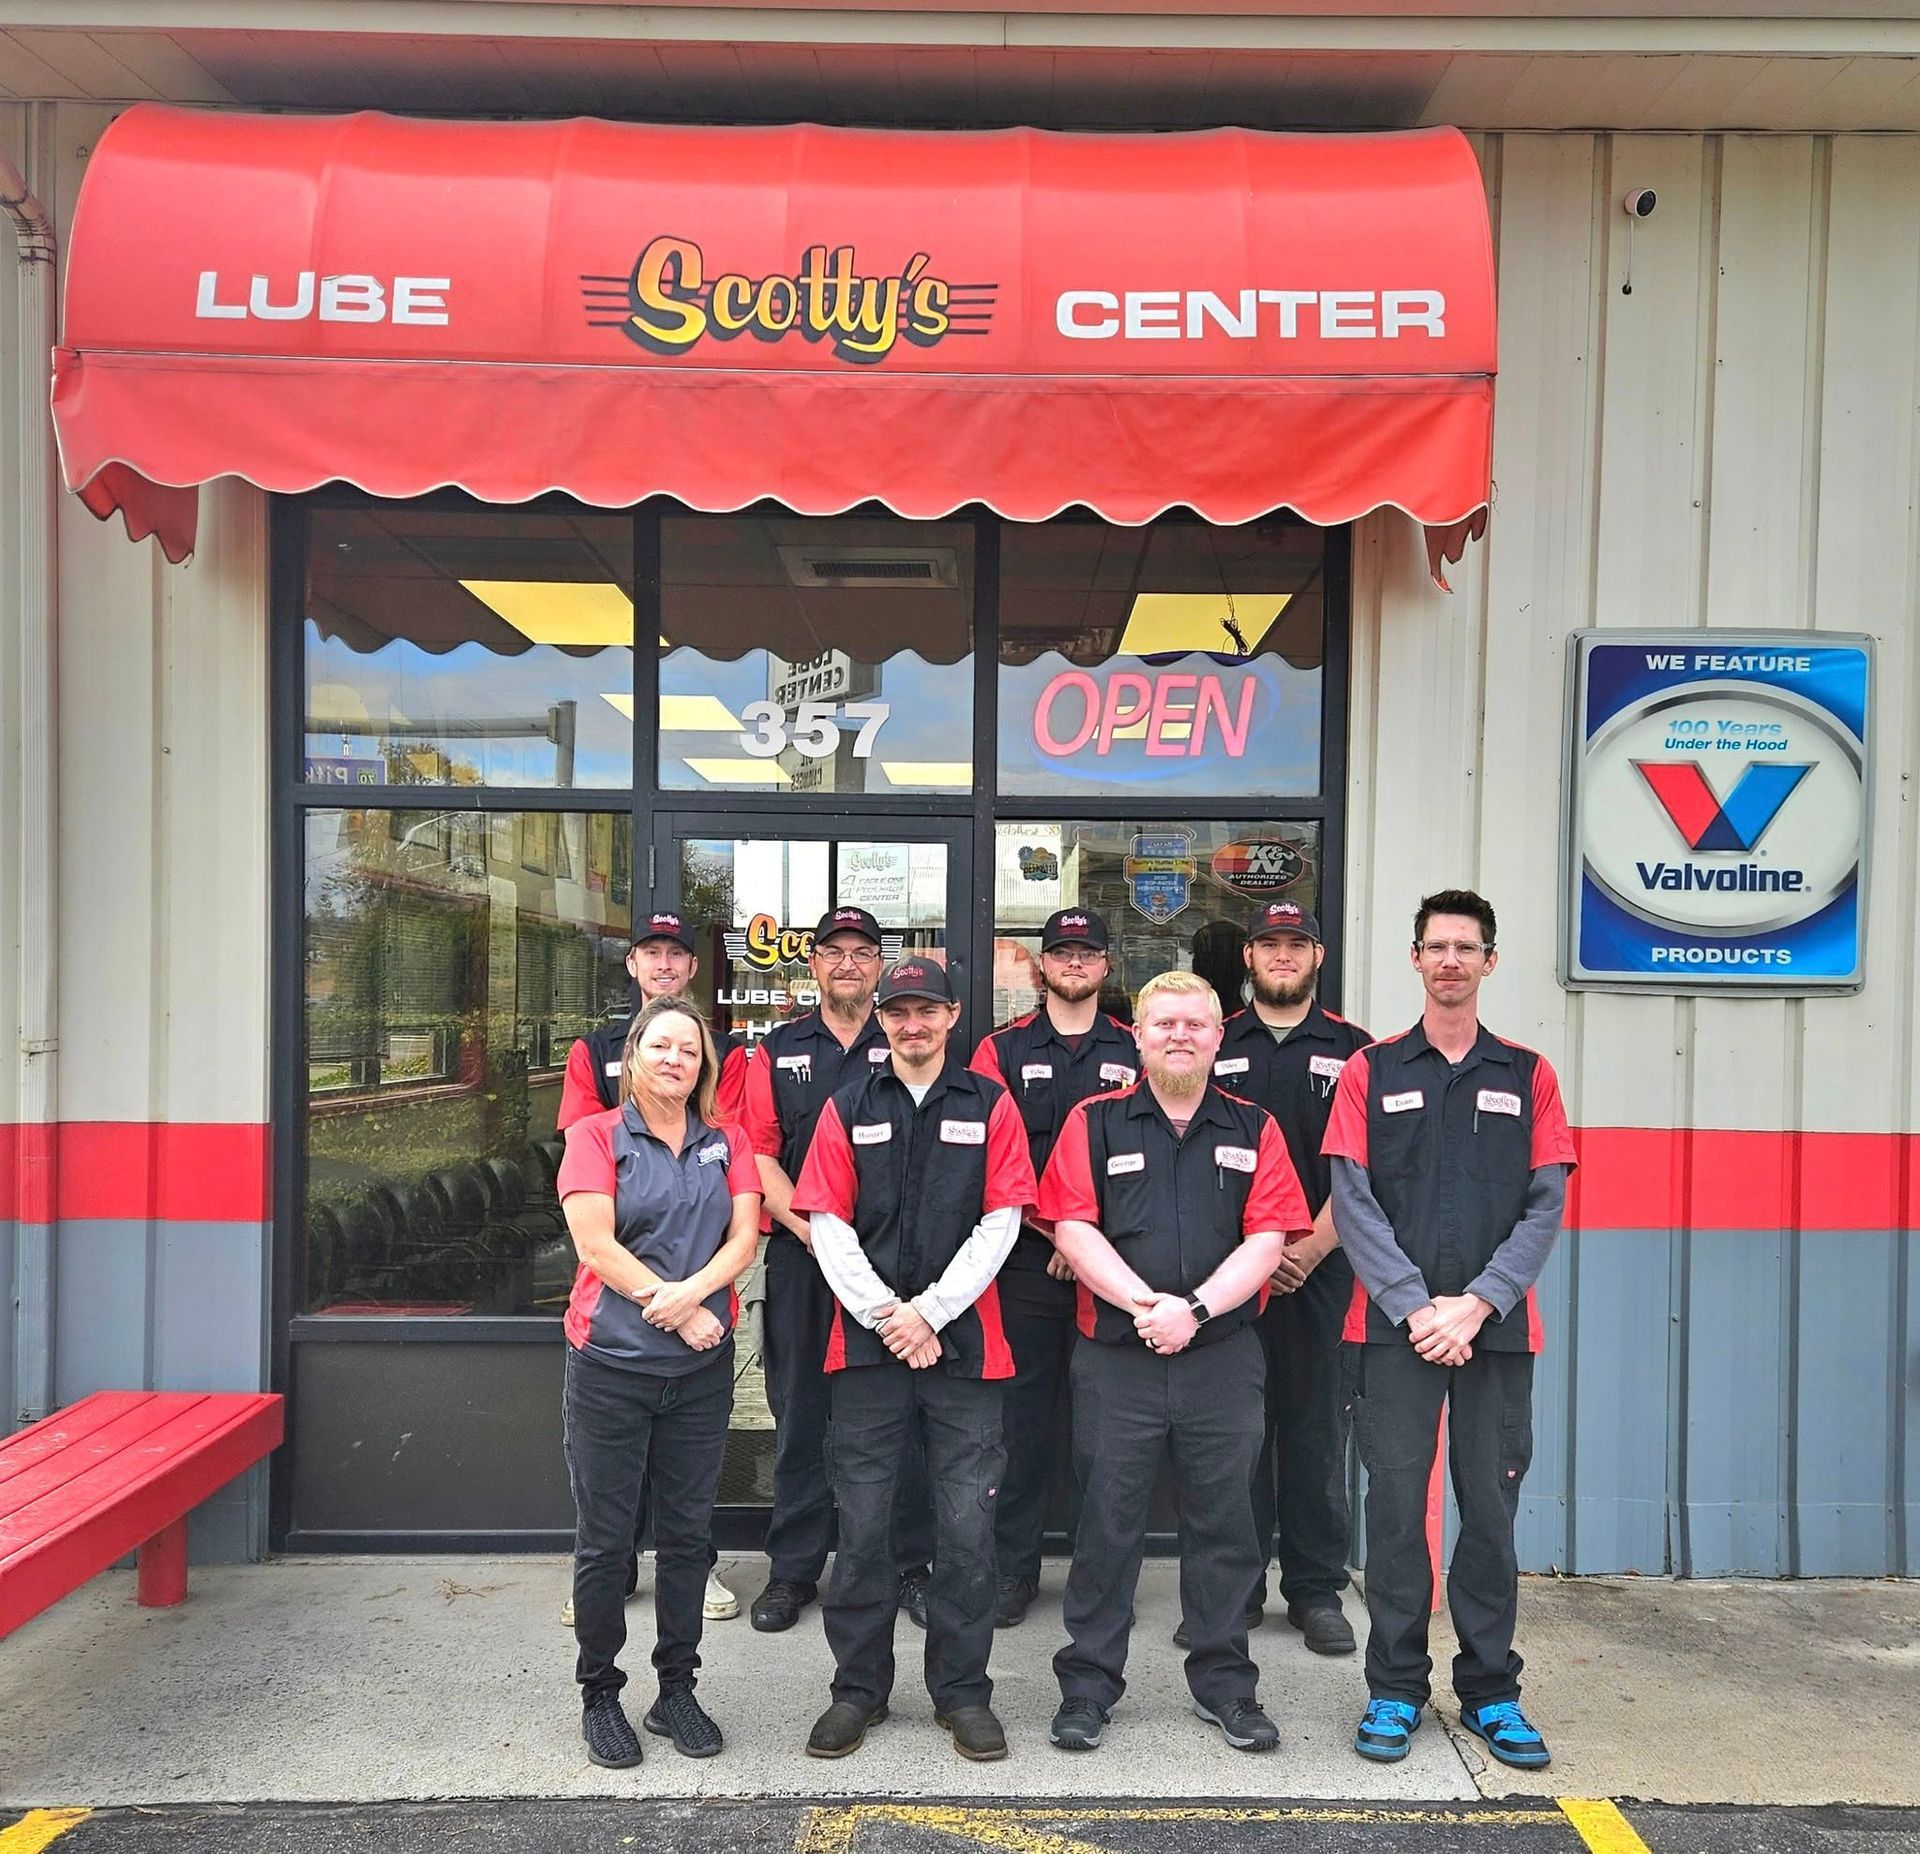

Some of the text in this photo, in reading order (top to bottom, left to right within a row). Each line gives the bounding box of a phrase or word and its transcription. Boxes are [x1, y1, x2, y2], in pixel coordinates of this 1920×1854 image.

[195, 271, 450, 325] LUBE
[623, 235, 951, 361] Scotty's
[1056, 289, 1446, 339] CENTER
[1645, 654, 1810, 672] WE FEATURE
[1033, 671, 1257, 758] OPEN
[739, 700, 890, 758] 357
[1668, 719, 1782, 736] 100 Years
[1665, 738, 1788, 751] Under the Hood
[1636, 862, 1804, 892] Valvoline
[1269, 902, 1299, 915] Scotty's
[1651, 947, 1792, 965] PRODUCTS
[717, 989, 787, 1005] LUBE
[1395, 1098, 1414, 1107] Evan
